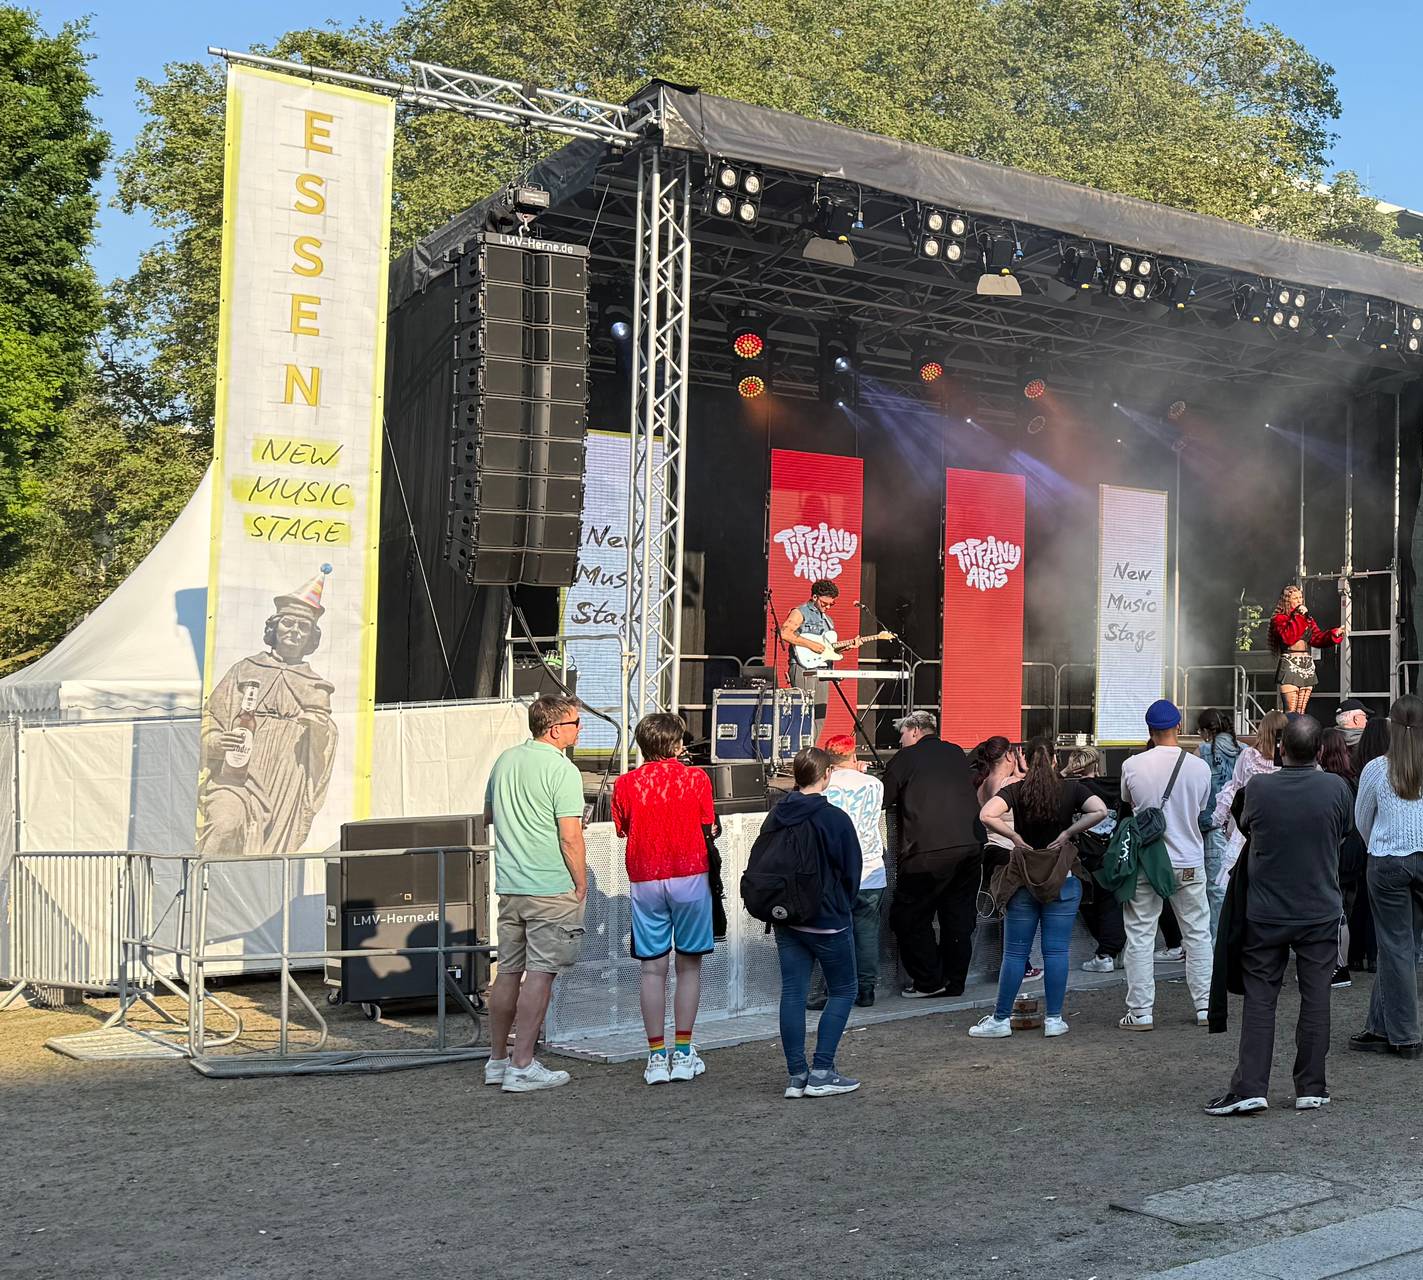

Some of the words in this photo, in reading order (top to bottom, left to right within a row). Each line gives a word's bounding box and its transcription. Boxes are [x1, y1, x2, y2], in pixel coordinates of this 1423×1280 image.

[499, 234, 574, 254] LMV-Herne.de
[284, 109, 333, 407] ESSEN
[261, 439, 344, 465] NEW
[248, 476, 350, 505] MUSIC
[251, 516, 345, 542] STAGE
[1113, 562, 1152, 581] New
[1107, 590, 1157, 612] Music
[1105, 622, 1156, 653] Stage
[353, 911, 440, 927] LMV-Herne.de
